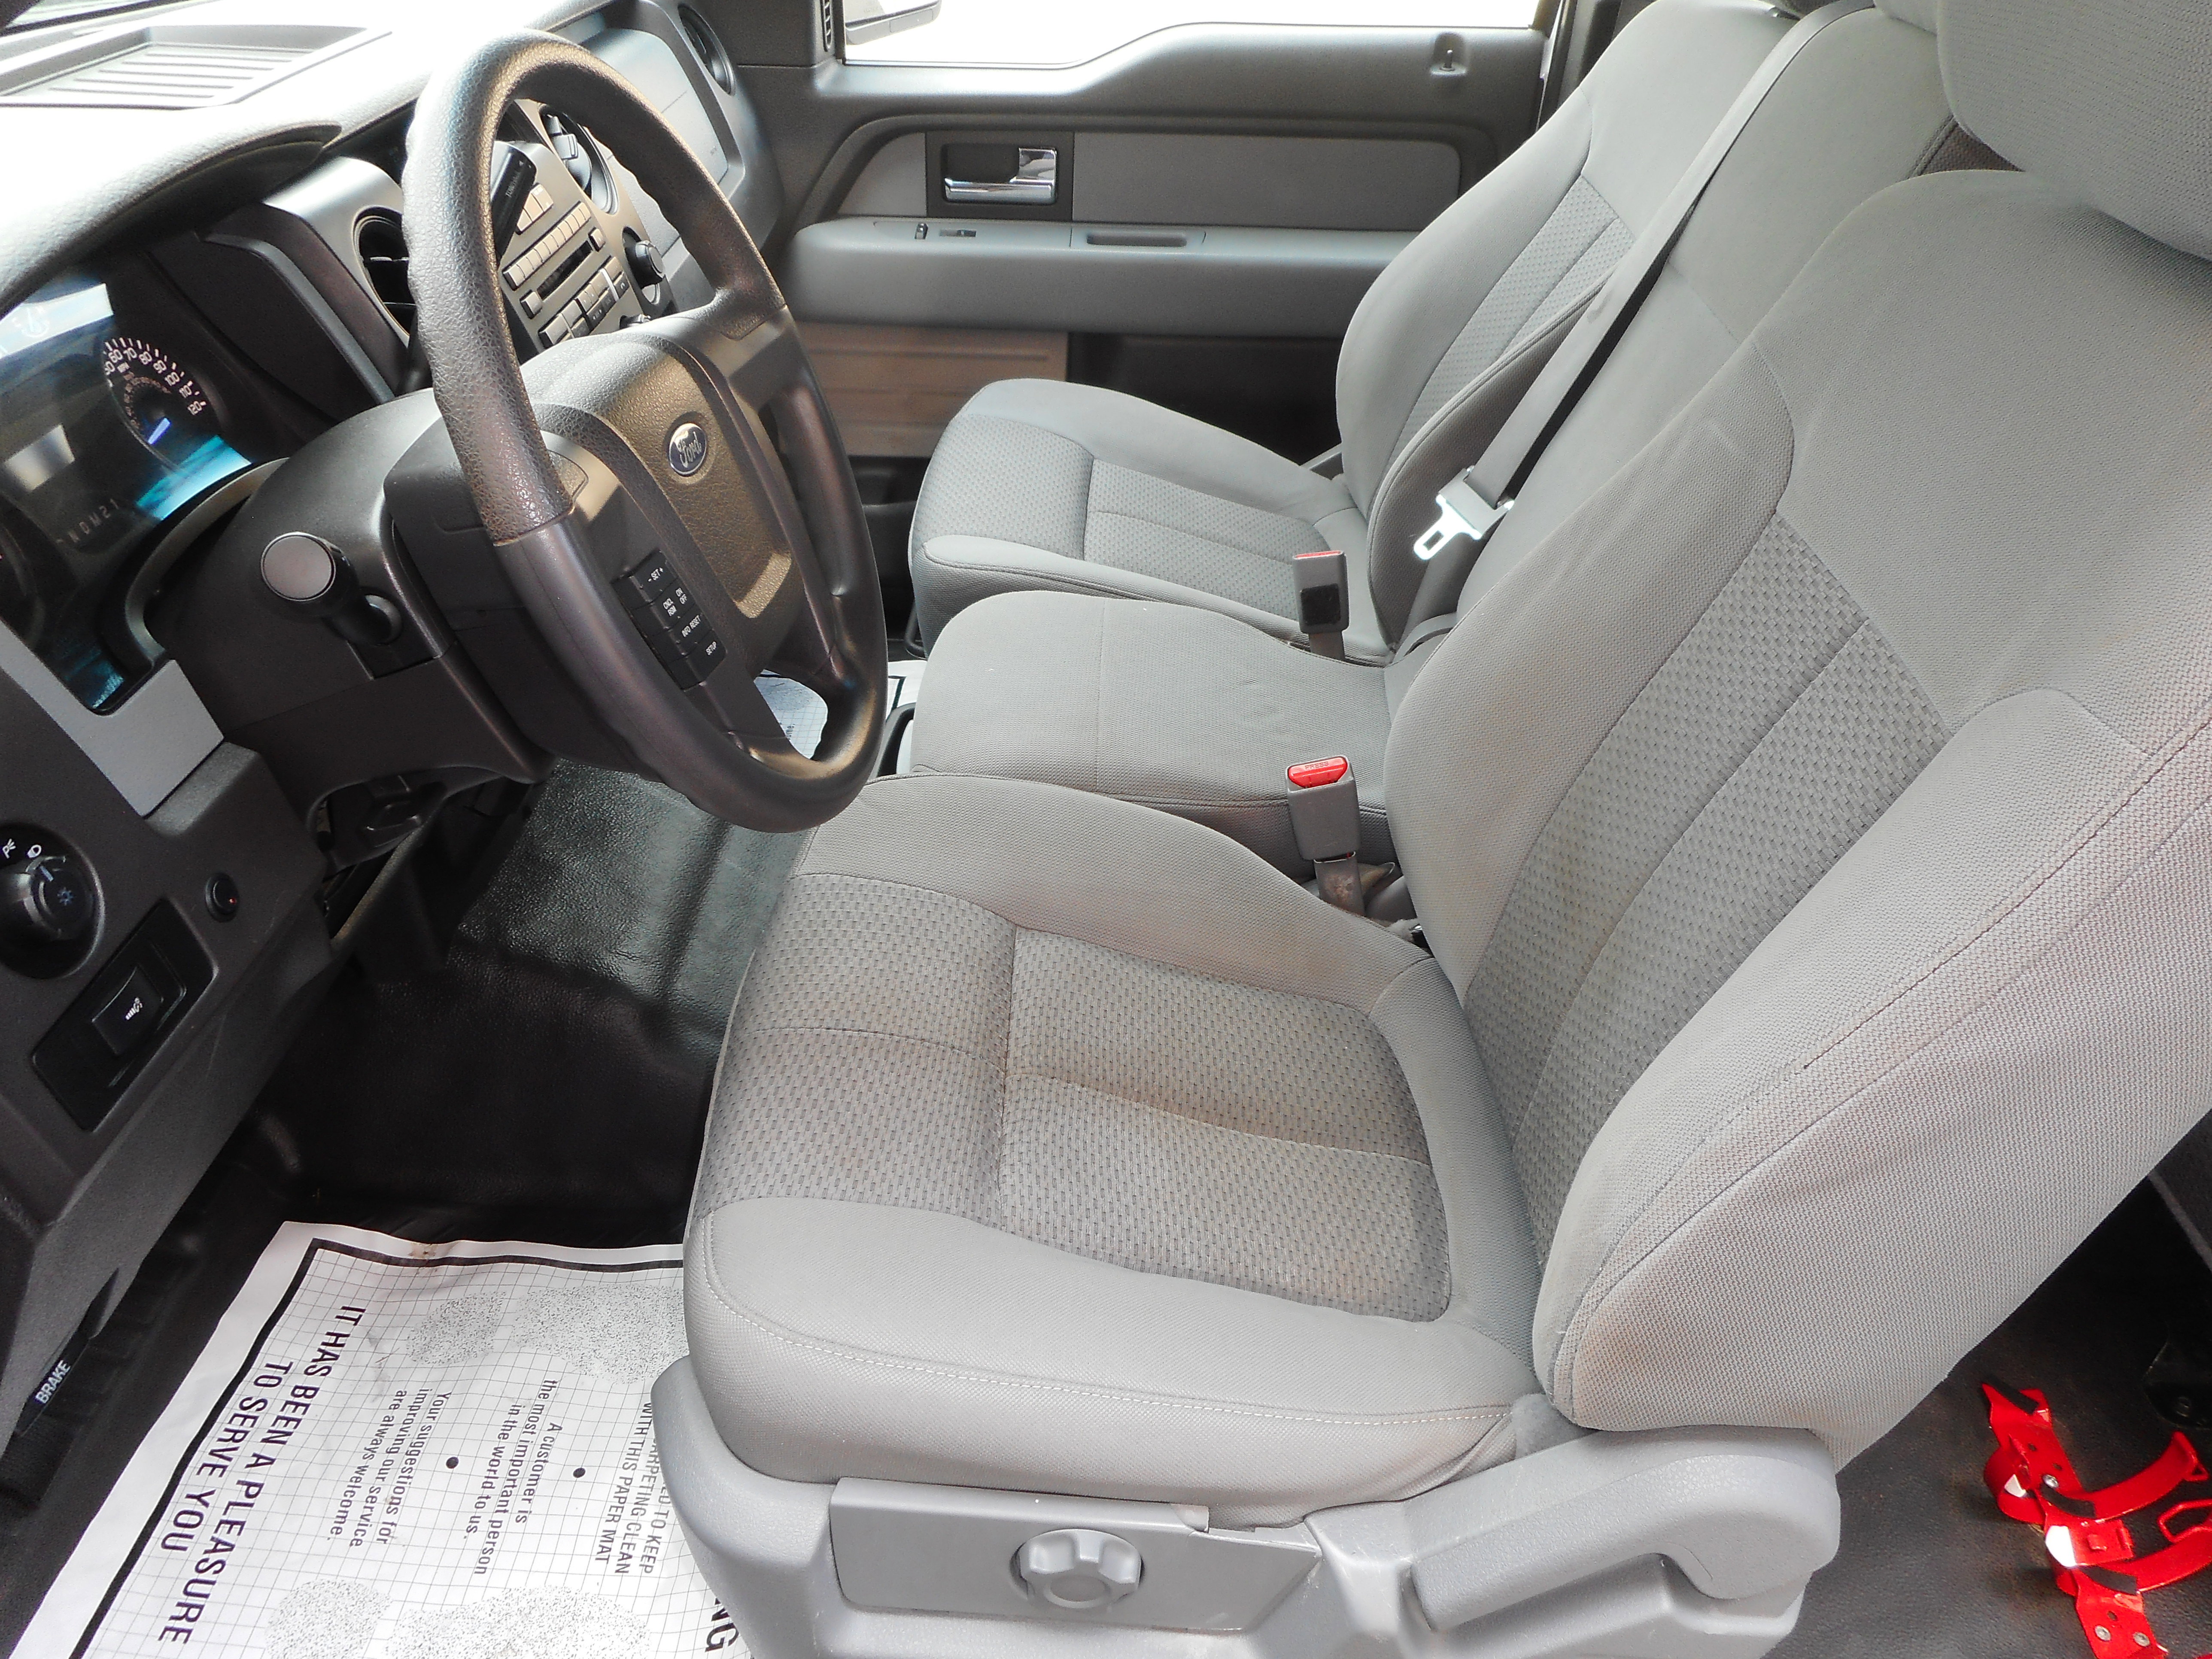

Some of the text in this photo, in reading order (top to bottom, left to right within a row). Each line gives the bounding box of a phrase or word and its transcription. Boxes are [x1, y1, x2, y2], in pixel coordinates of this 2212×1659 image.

[108, 349, 123, 363] 60
[123, 347, 137, 361] 70
[139, 351, 152, 365] 80
[153, 360, 167, 374] 90
[164, 372, 180, 386] 100
[179, 385, 192, 398] 110
[187, 400, 202, 415] 120
[675, 430, 702, 468] Ford
[650, 568, 661, 580] SET
[675, 587, 684, 597] ON
[679, 593, 687, 605] OFF
[705, 641, 717, 656] SETUP
[1304, 761, 1329, 770] PRESS
[35, 1360, 71, 1404] BRAKE
[161, 1361, 294, 1552] TO SERVE YOU
[327, 1390, 408, 1540] are always welcome.
[349, 1388, 433, 1547] improving our service
[376, 1392, 452, 1544] Your suggestions for
[158, 1306, 366, 1644] IT HAS BEEN A PLEASURE
[463, 1404, 526, 1539] in the world to us.
[474, 1379, 559, 1575] the most important person
[515, 1422, 563, 1523] A customer is
[595, 1403, 653, 1565] WITH THIS PAPER MAT
[614, 1439, 660, 1574] ARPETING CLEAN
[651, 1510, 670, 1529] TO
[638, 1534, 662, 1574] KEEP
